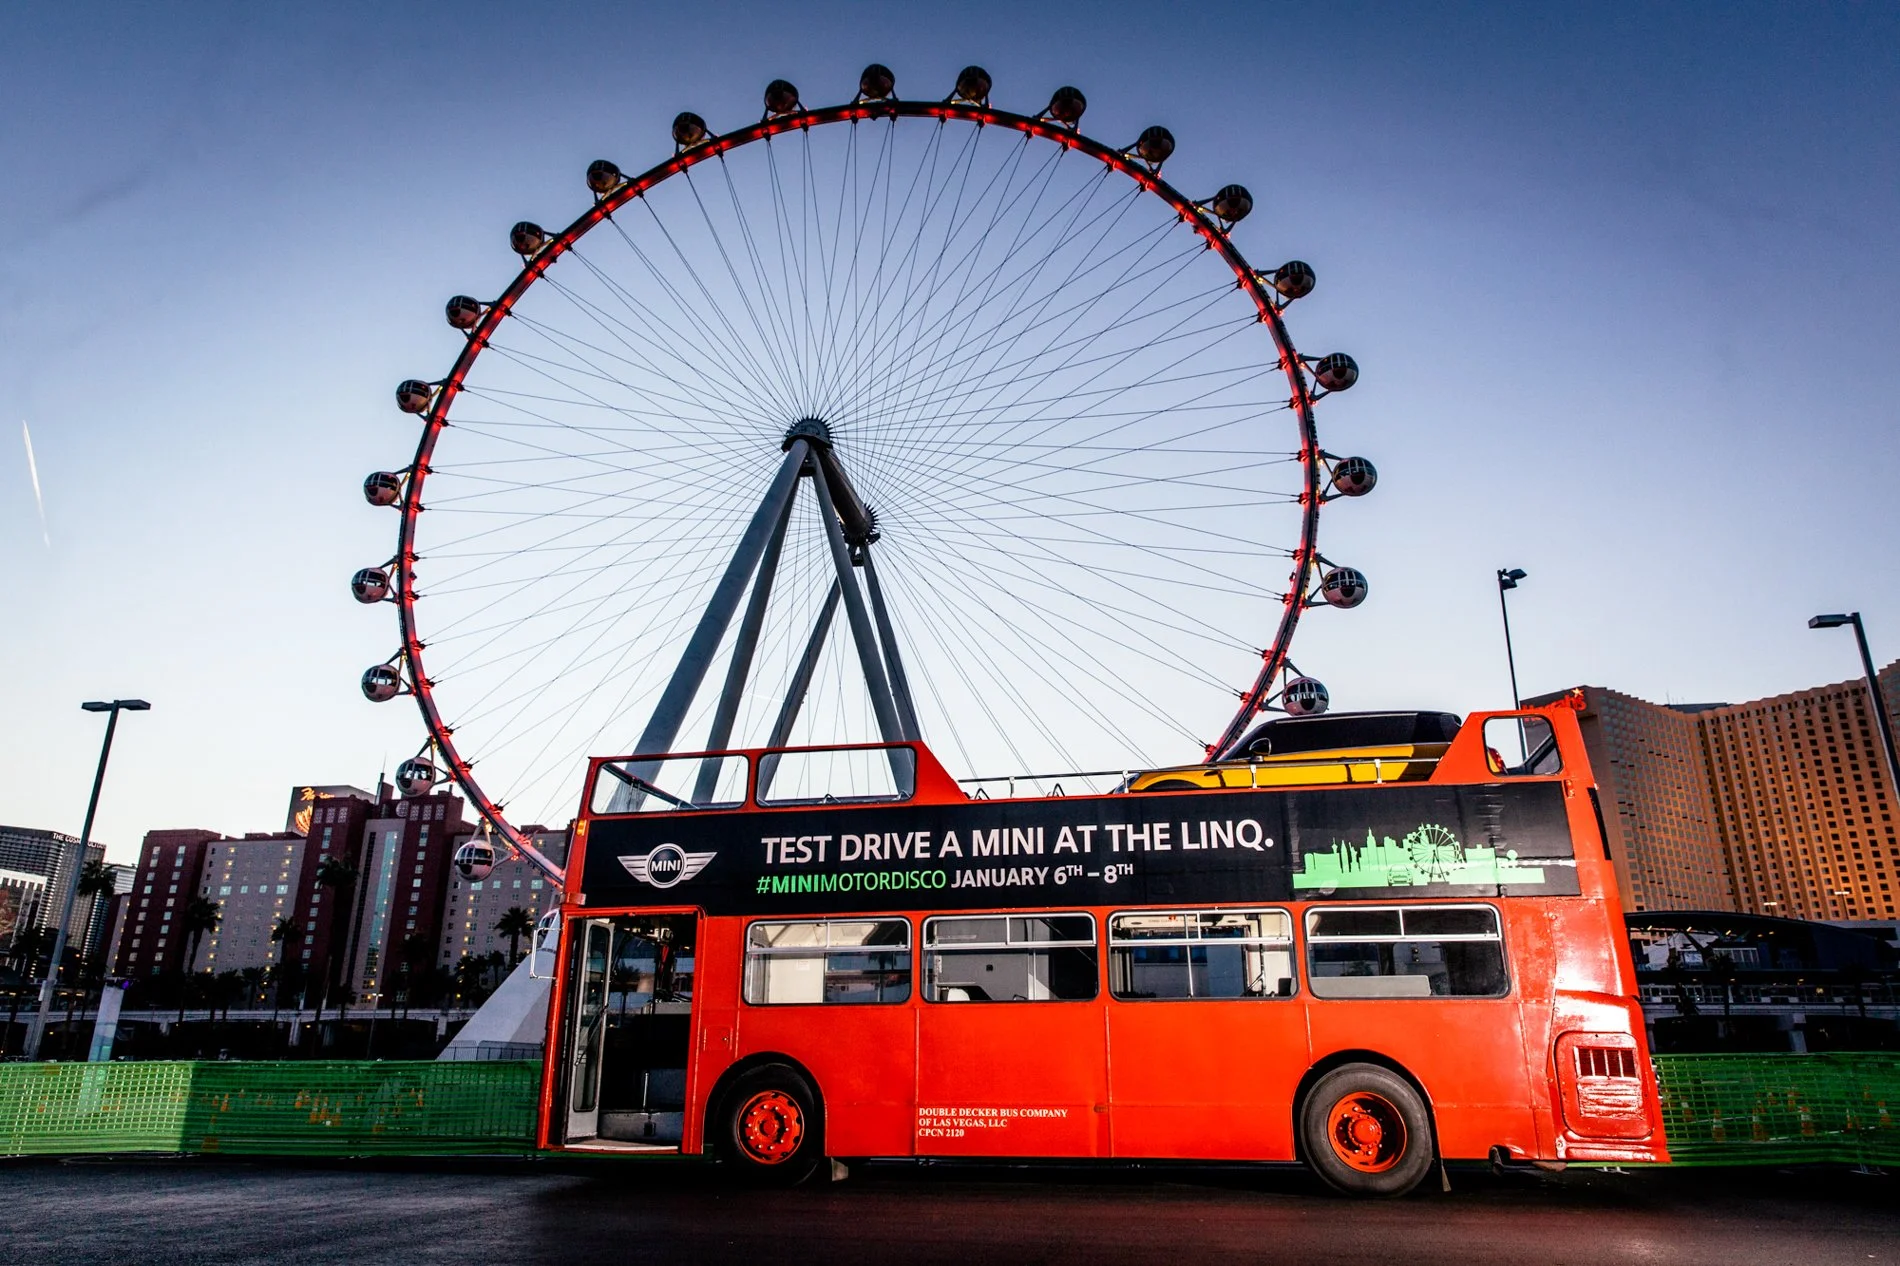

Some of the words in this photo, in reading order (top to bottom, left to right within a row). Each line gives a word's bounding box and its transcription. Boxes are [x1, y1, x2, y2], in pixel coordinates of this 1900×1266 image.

[53, 832, 64, 841] THE
[761, 835, 832, 864] TEST
[840, 831, 931, 861] DRIVE
[938, 831, 963, 858] A
[972, 827, 1044, 857] MINI
[1053, 825, 1097, 853] AT
[1105, 822, 1171, 852] THE
[1181, 819, 1274, 851] LINQ.
[651, 859, 682, 872] MINI
[756, 870, 947, 894] #MINIMOTORDISCO
[951, 867, 1049, 888] JANUARY
[1054, 865, 1083, 885] 6TH
[1104, 863, 1134, 884] 8TH
[919, 1107, 957, 1117] DOUBLE
[959, 1108, 998, 1117] DECKER
[1000, 1108, 1018, 1117] BUS
[1020, 1109, 1068, 1118] COMPANY
[933, 1119, 951, 1127] LAS
[953, 1119, 987, 1129] VEGAS,
[989, 1119, 1008, 1127] LLC
[918, 1128, 944, 1137] CPCN
[946, 1128, 965, 1137] 2120
